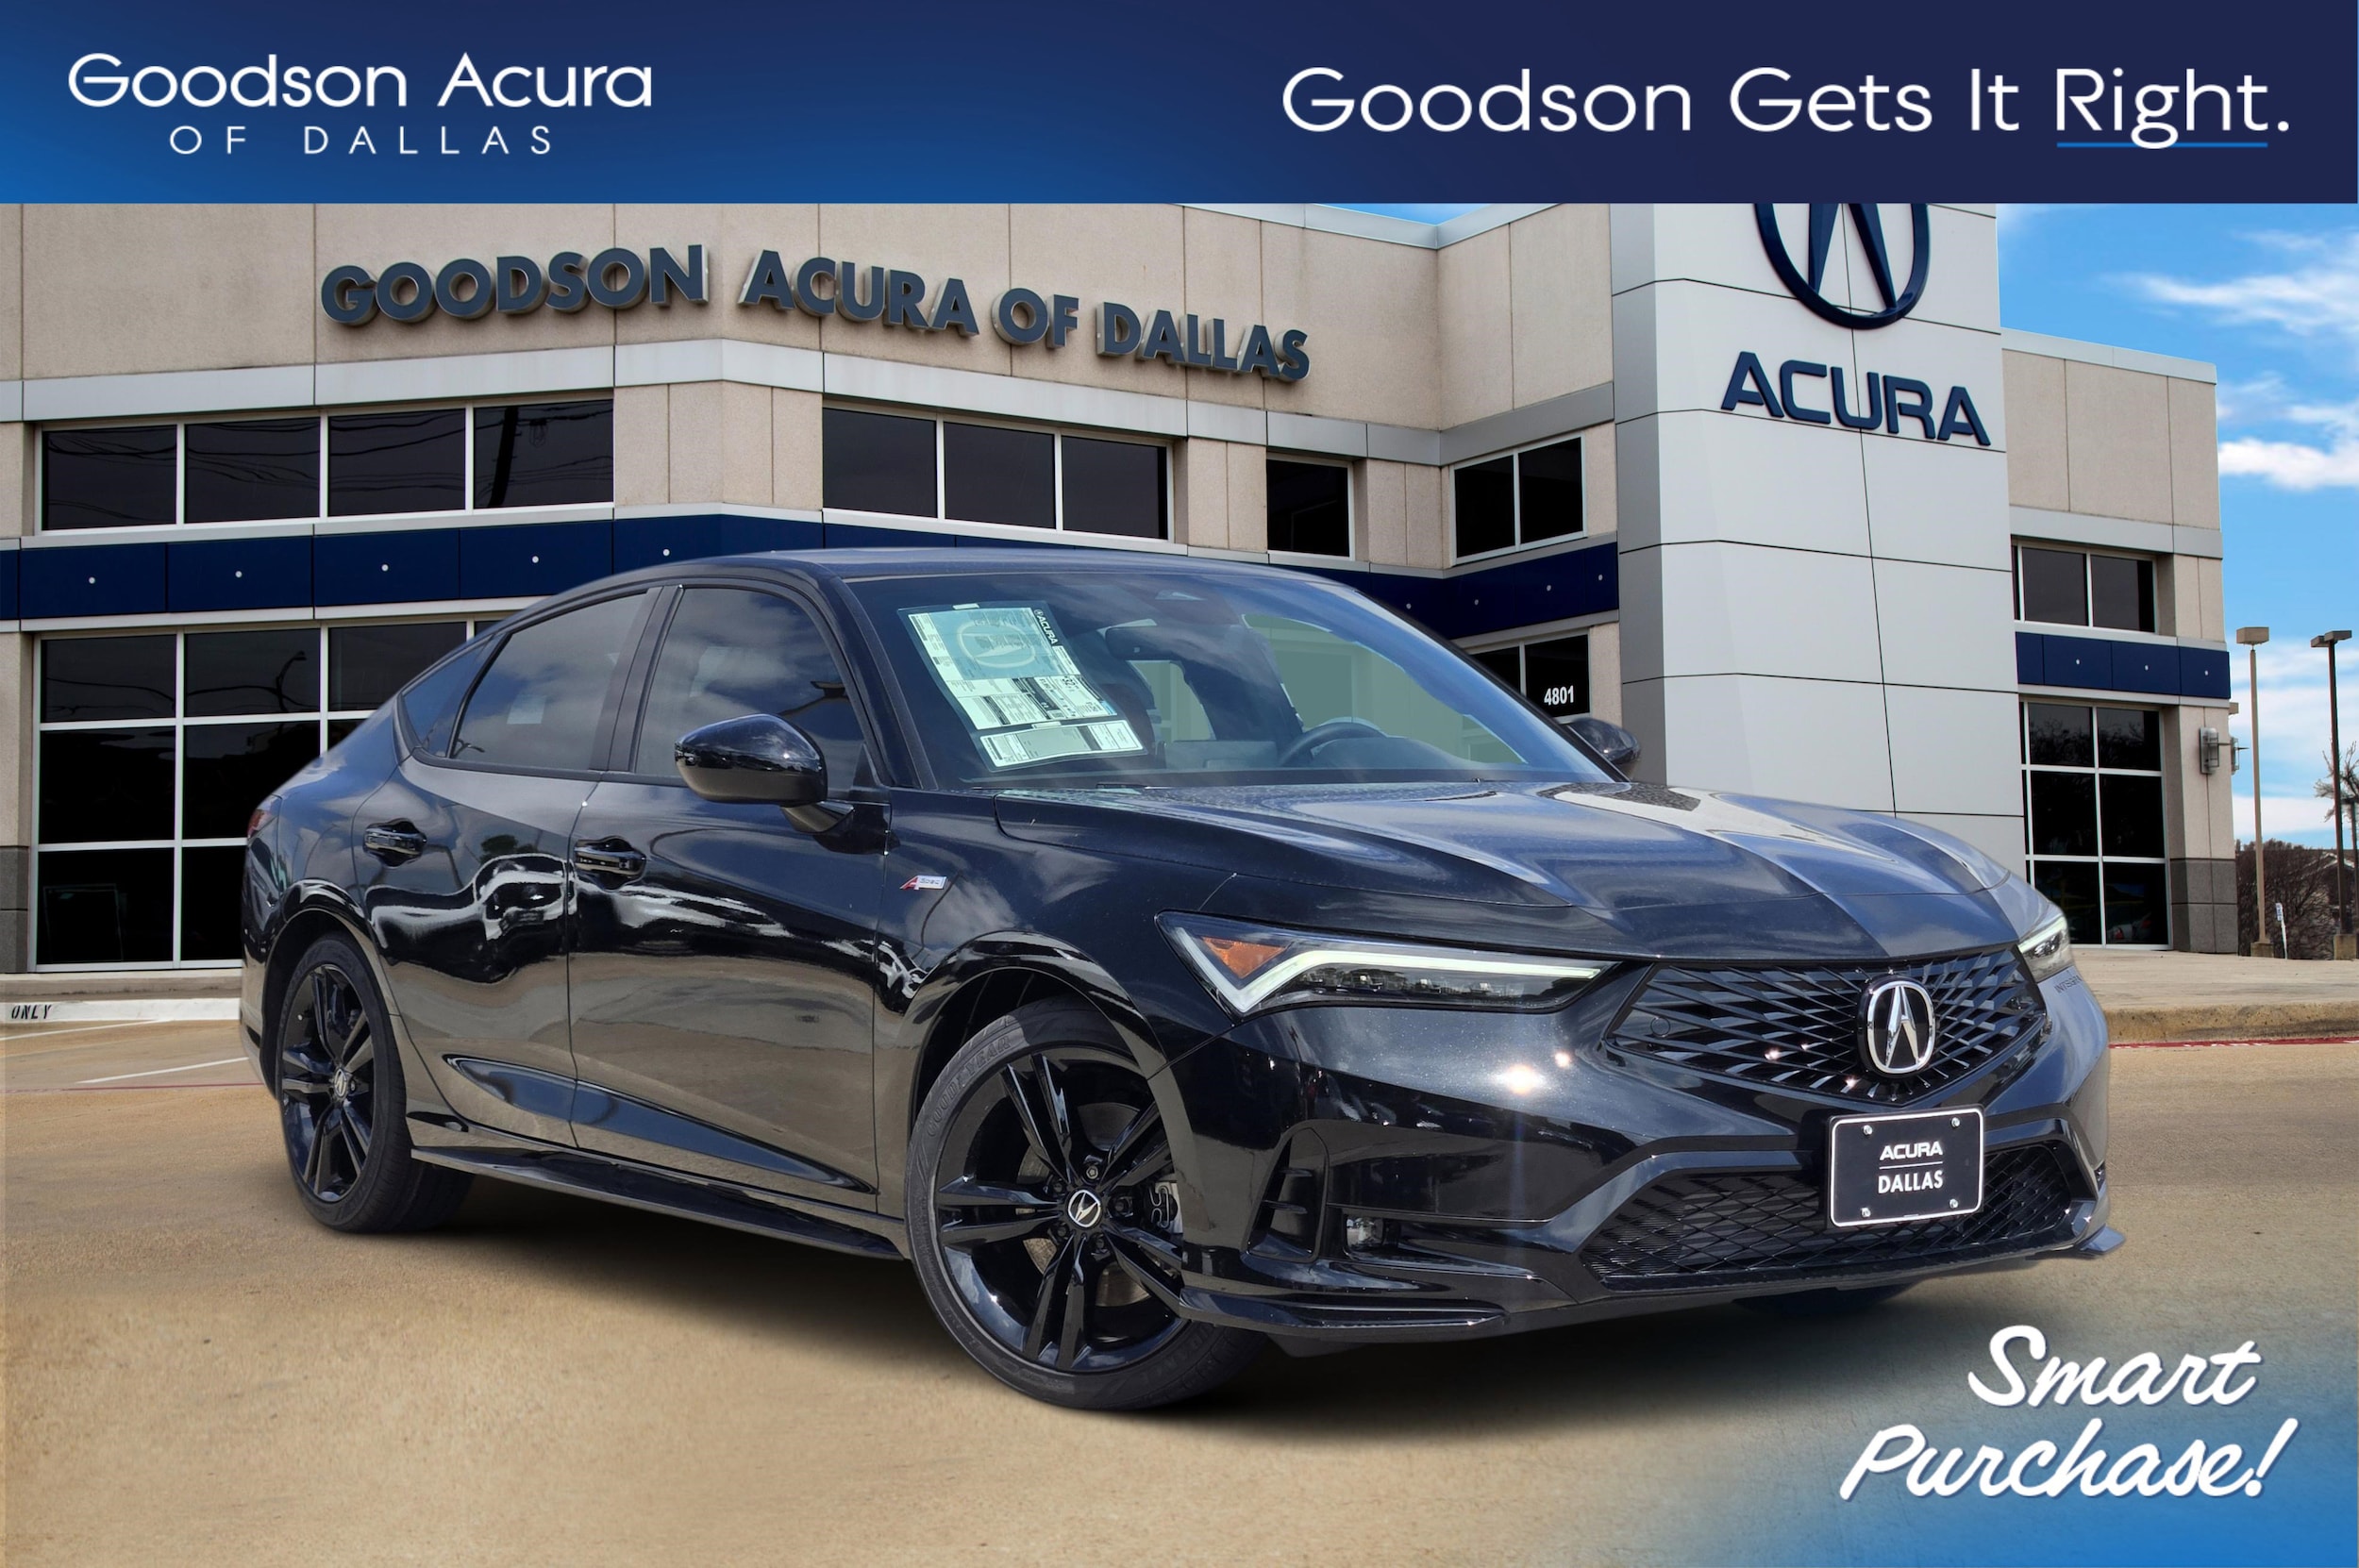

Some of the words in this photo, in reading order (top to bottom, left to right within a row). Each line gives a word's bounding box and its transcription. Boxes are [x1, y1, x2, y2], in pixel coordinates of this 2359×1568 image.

[321, 244, 710, 326] GOODSON
[738, 249, 980, 337] ACURA
[991, 287, 1079, 348] OF
[1096, 301, 1311, 382] DALLAS
[1720, 350, 1992, 447] ACURA
[1037, 615, 1059, 644] ACURA
[1544, 685, 1575, 706] 4801
[11, 1004, 52, 1020] ONLY
[1879, 1140, 1944, 1161] ACURA
[1878, 1169, 1945, 1193] DALLAS
